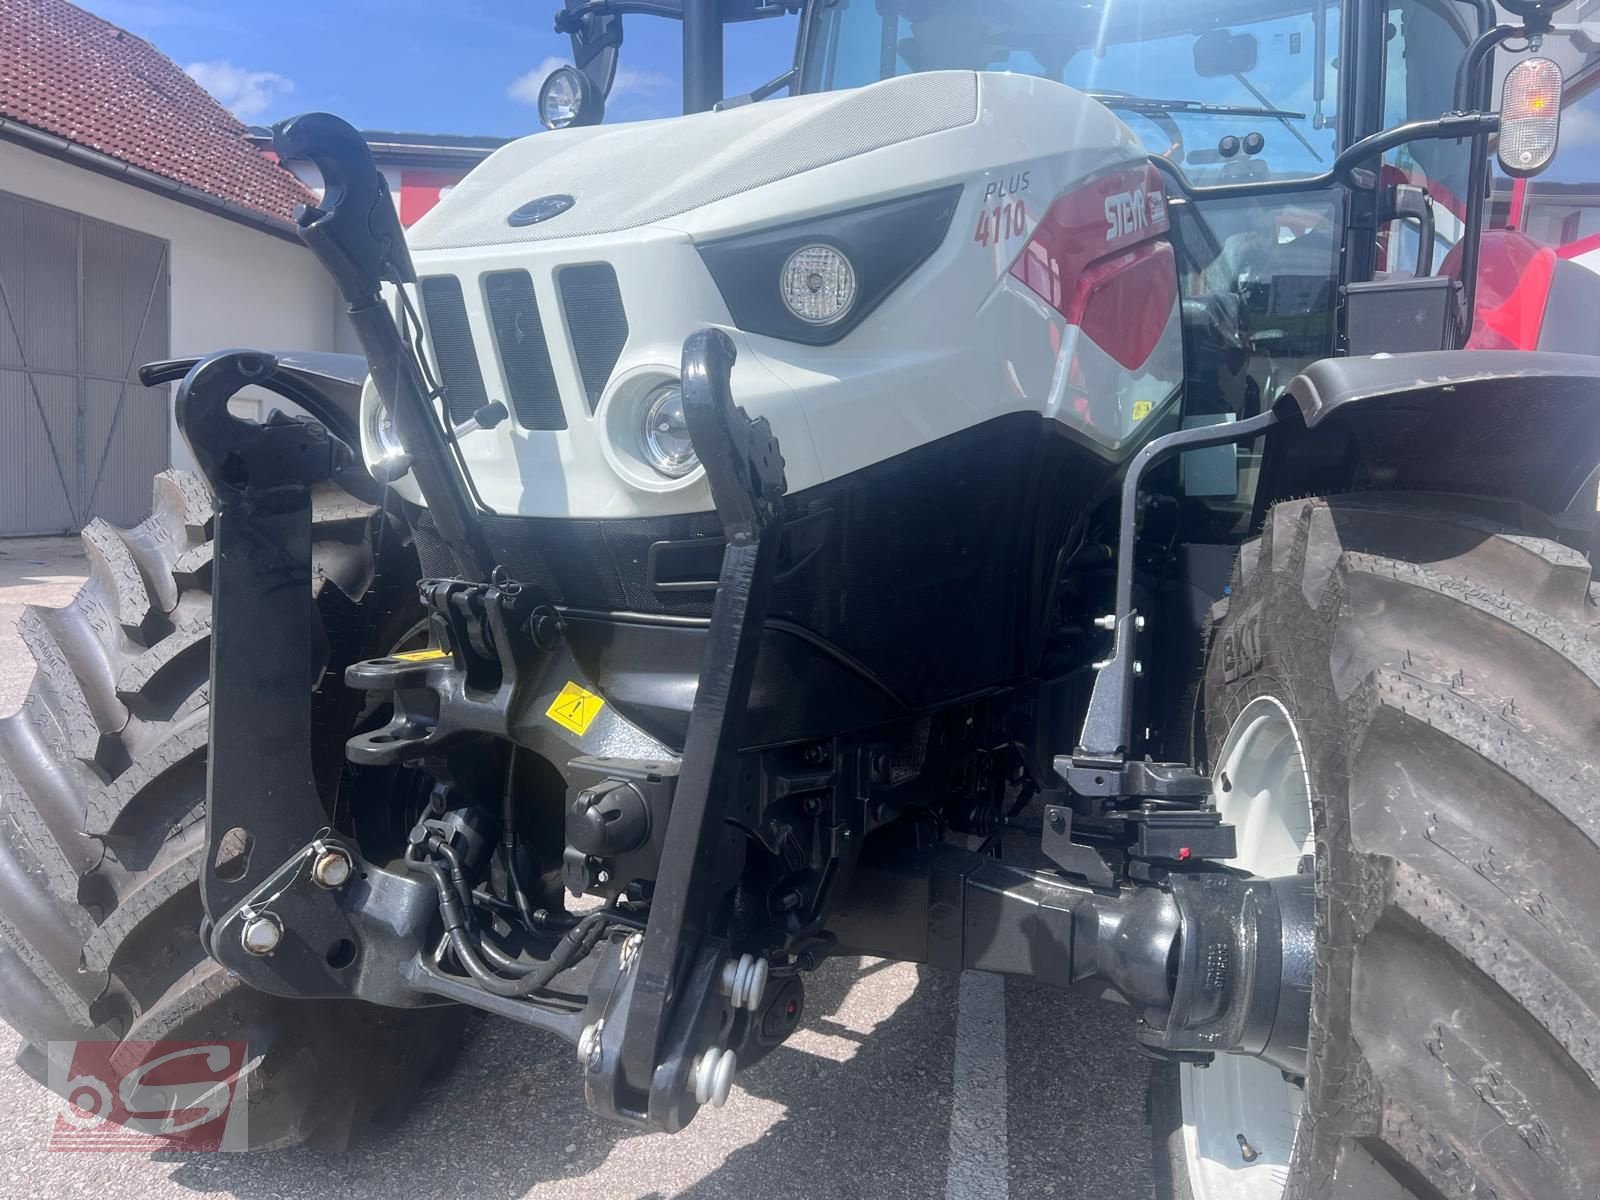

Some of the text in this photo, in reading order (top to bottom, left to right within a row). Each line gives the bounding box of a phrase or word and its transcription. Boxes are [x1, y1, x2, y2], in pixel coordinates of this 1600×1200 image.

[984, 171, 1031, 202] PLUS
[974, 200, 1025, 247] 4110
[1104, 189, 1147, 241] STEYR
